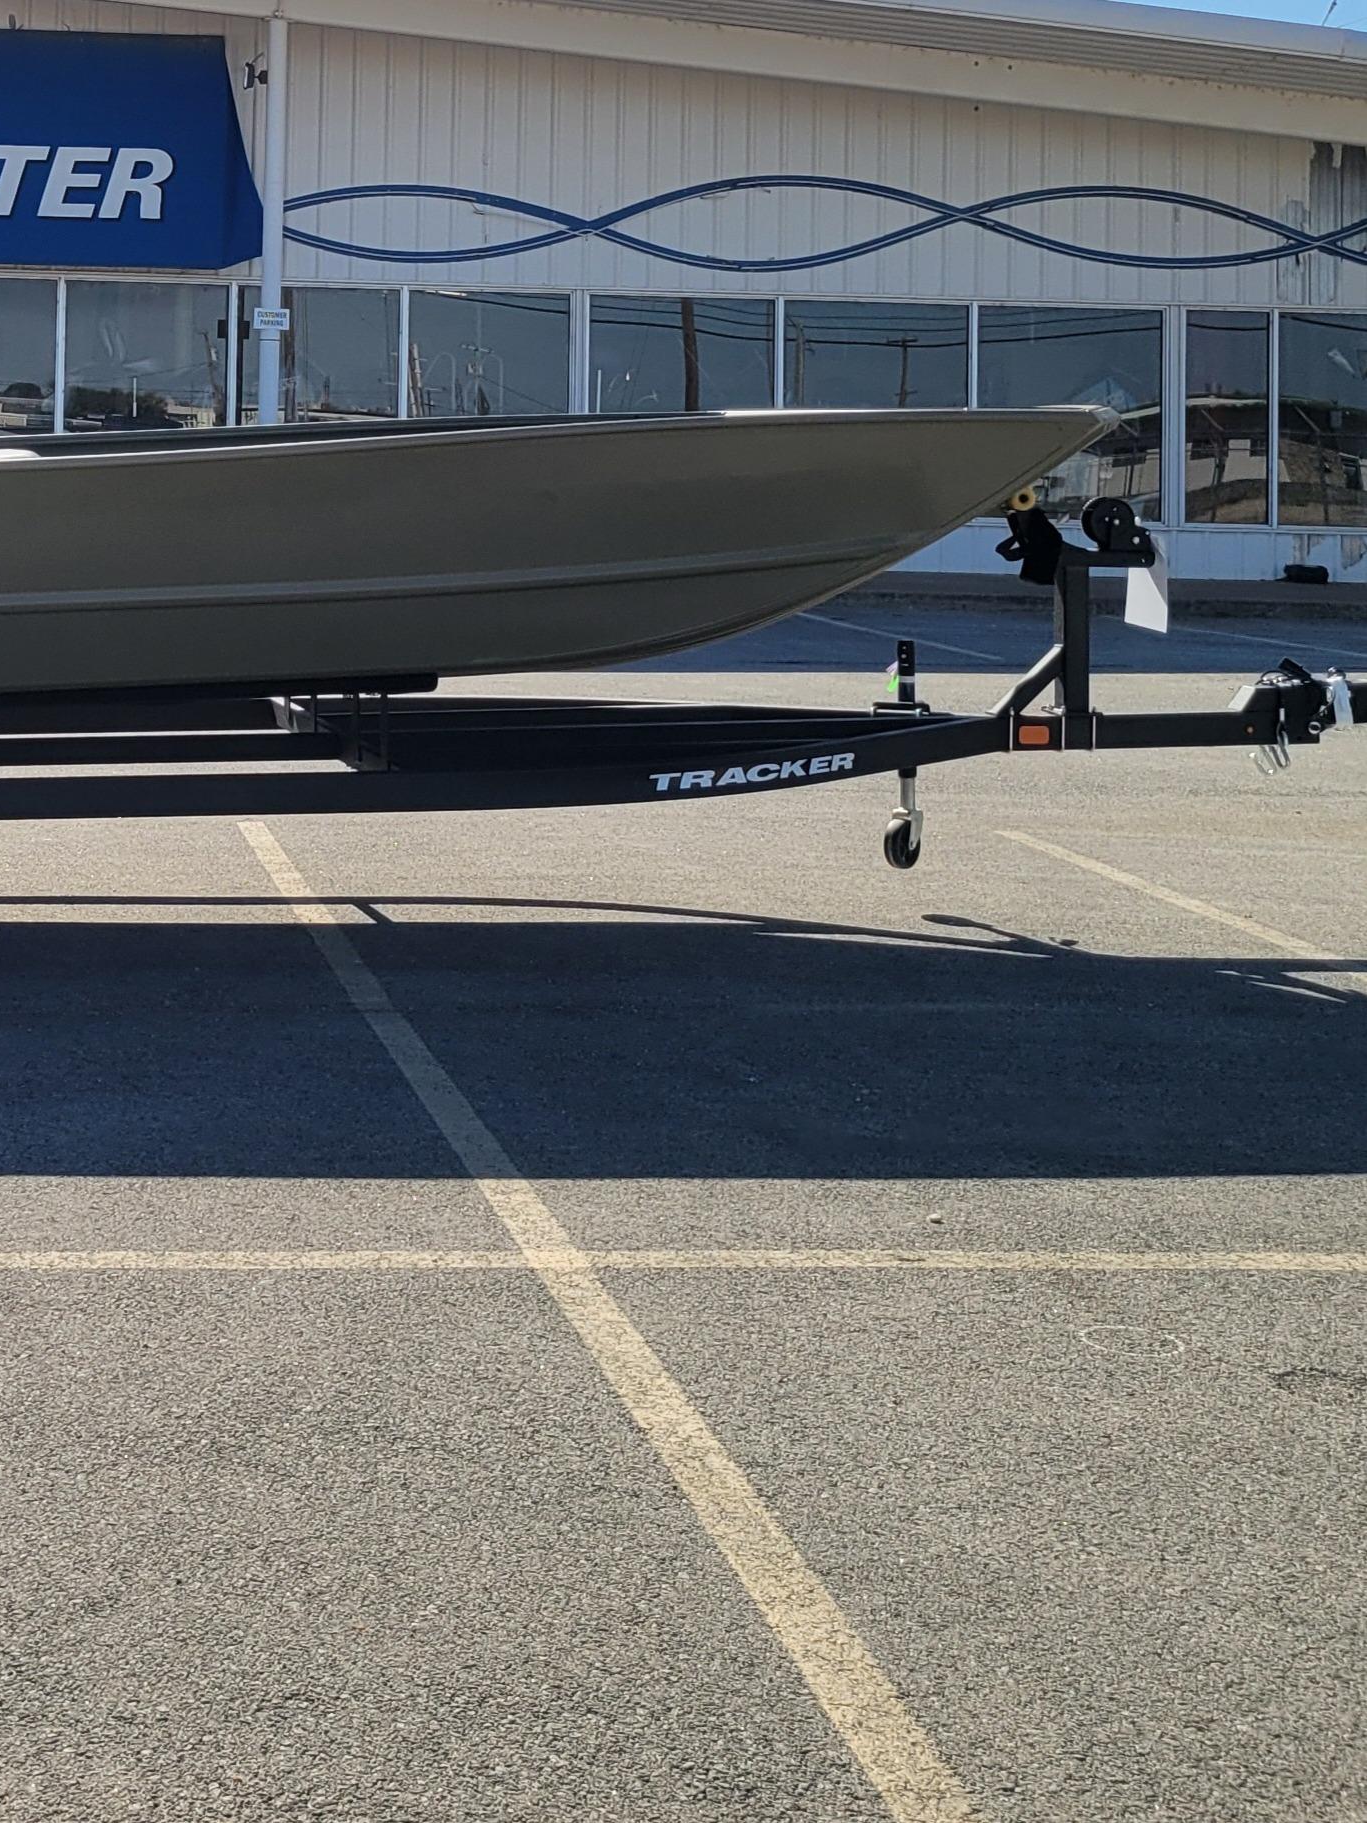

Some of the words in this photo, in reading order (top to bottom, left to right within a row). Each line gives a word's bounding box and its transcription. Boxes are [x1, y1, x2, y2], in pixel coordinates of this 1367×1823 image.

[257, 311, 288, 319] CUSTOMER
[259, 319, 284, 327] PARKING
[649, 753, 855, 791] TRACKER
